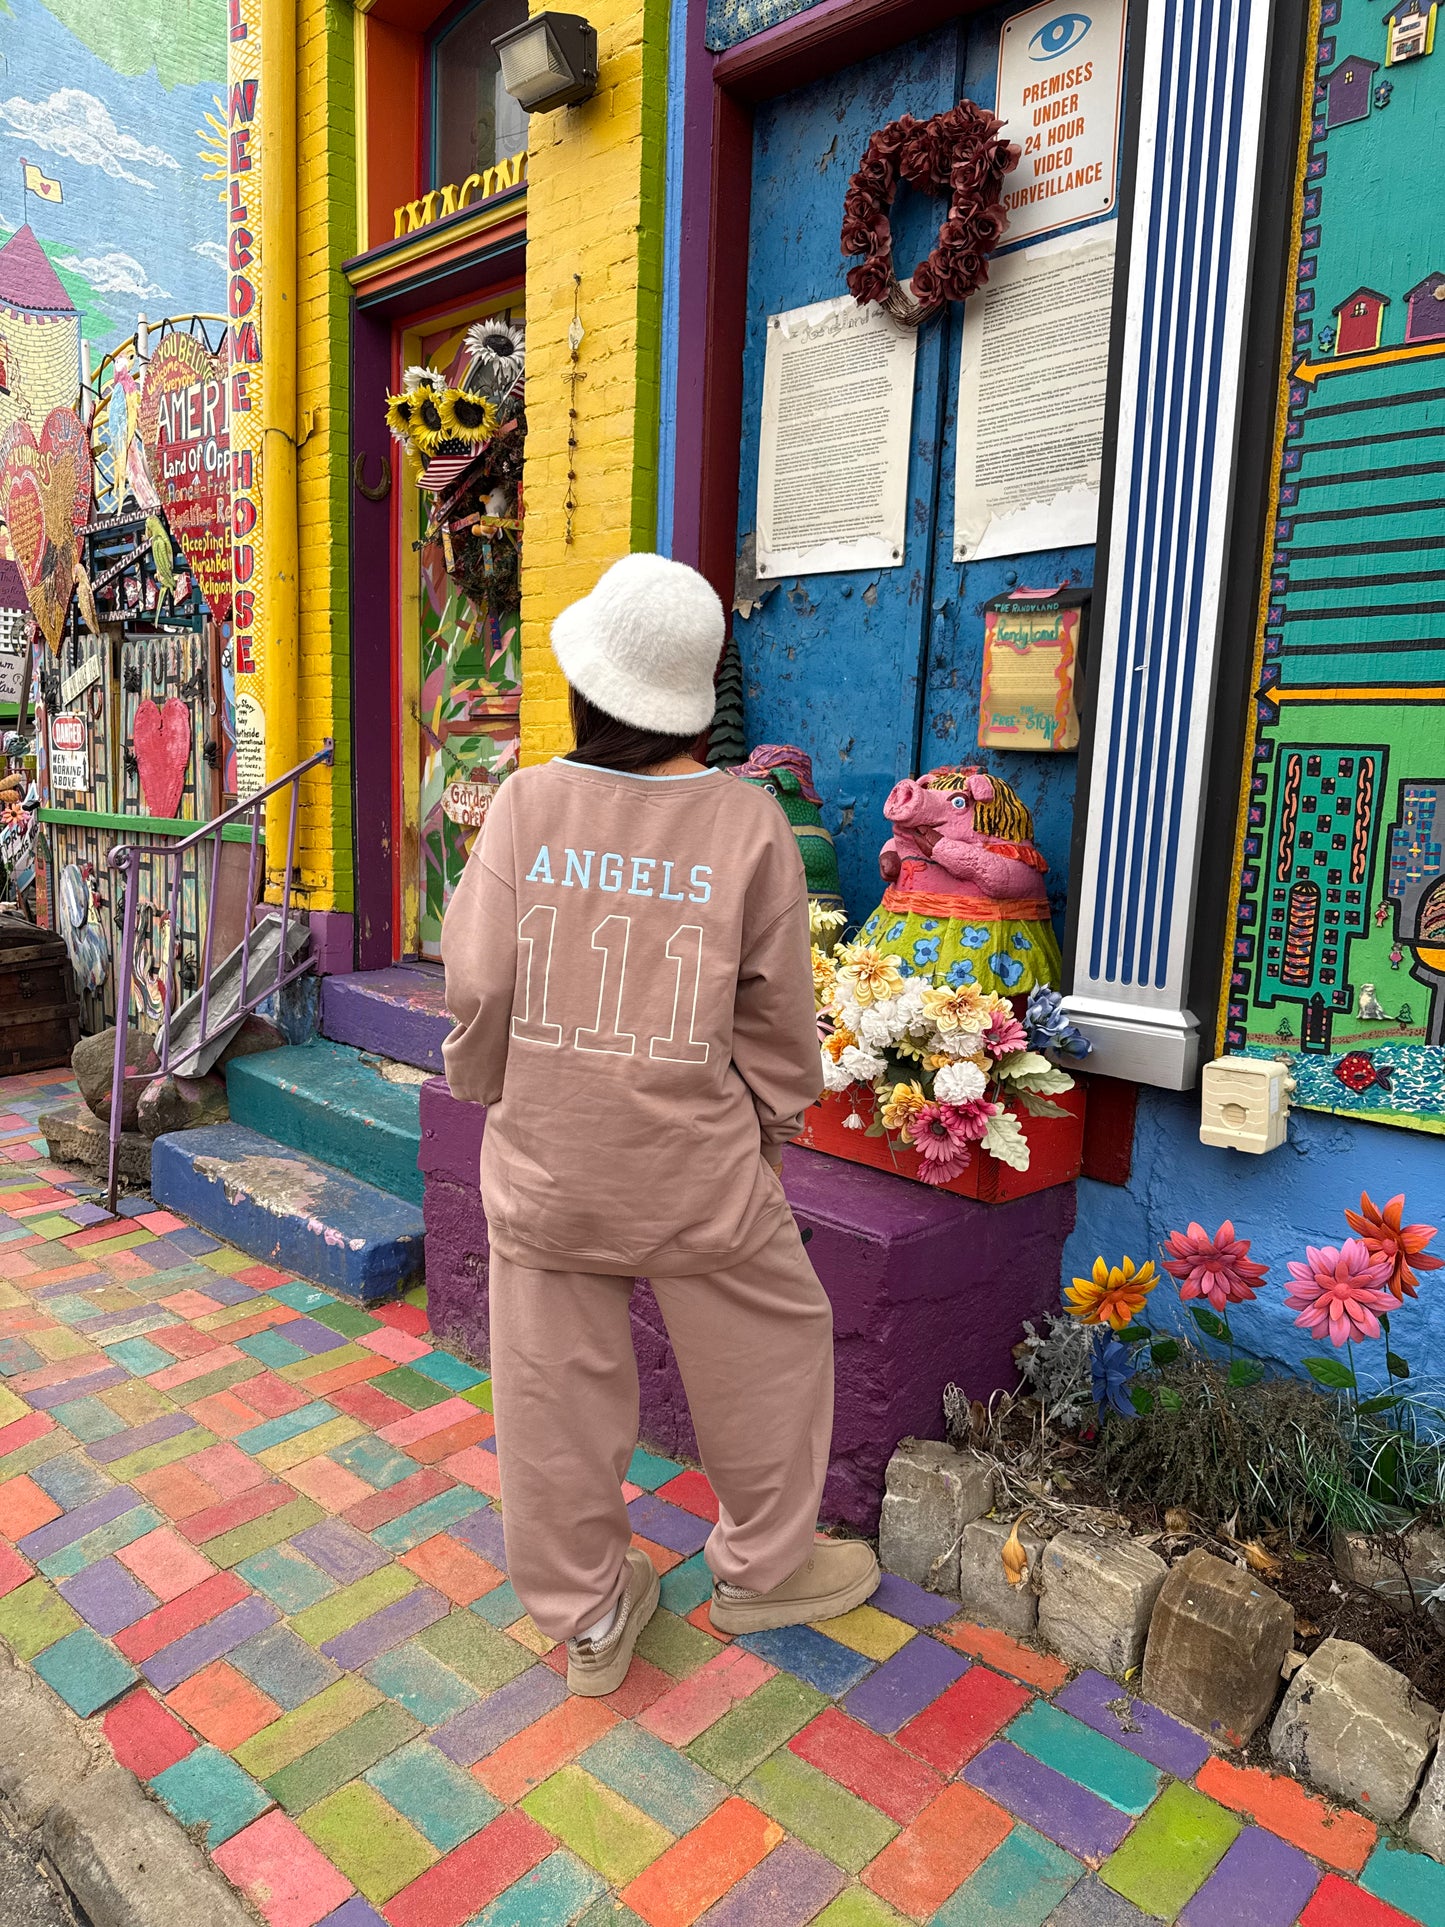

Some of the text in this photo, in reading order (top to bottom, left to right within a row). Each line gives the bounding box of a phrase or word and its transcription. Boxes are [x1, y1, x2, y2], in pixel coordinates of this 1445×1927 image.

[1022, 61, 1093, 106] PREMISES
[1033, 93, 1079, 127] UNDER
[1024, 117, 1085, 156] 24 HOUR
[1033, 146, 1073, 177] VIDEO
[1003, 161, 1103, 211] SURVEILLANCE
[158, 333, 177, 363] YOU
[178, 335, 215, 387] BELONG
[147, 361, 178, 395] Welcome
[163, 373, 196, 394] Everyone
[229, 79, 262, 674] WELCOME HOUSE
[163, 452, 186, 478] Land
[182, 530, 224, 557] Accepting
[192, 555, 215, 574] Human
[199, 574, 231, 604] Religion
[994, 602, 1060, 613] THE RANDYLAND
[241, 699, 256, 713] Story
[991, 713, 1015, 726] FREE
[55, 722, 82, 743] DANGER
[52, 753, 65, 764] MEN
[53, 765, 82, 777] WORKING
[53, 775, 76, 788] ABOVE
[451, 784, 492, 809] Garden
[526, 845, 712, 904] ANGELS
[512, 904, 710, 1064] 111
